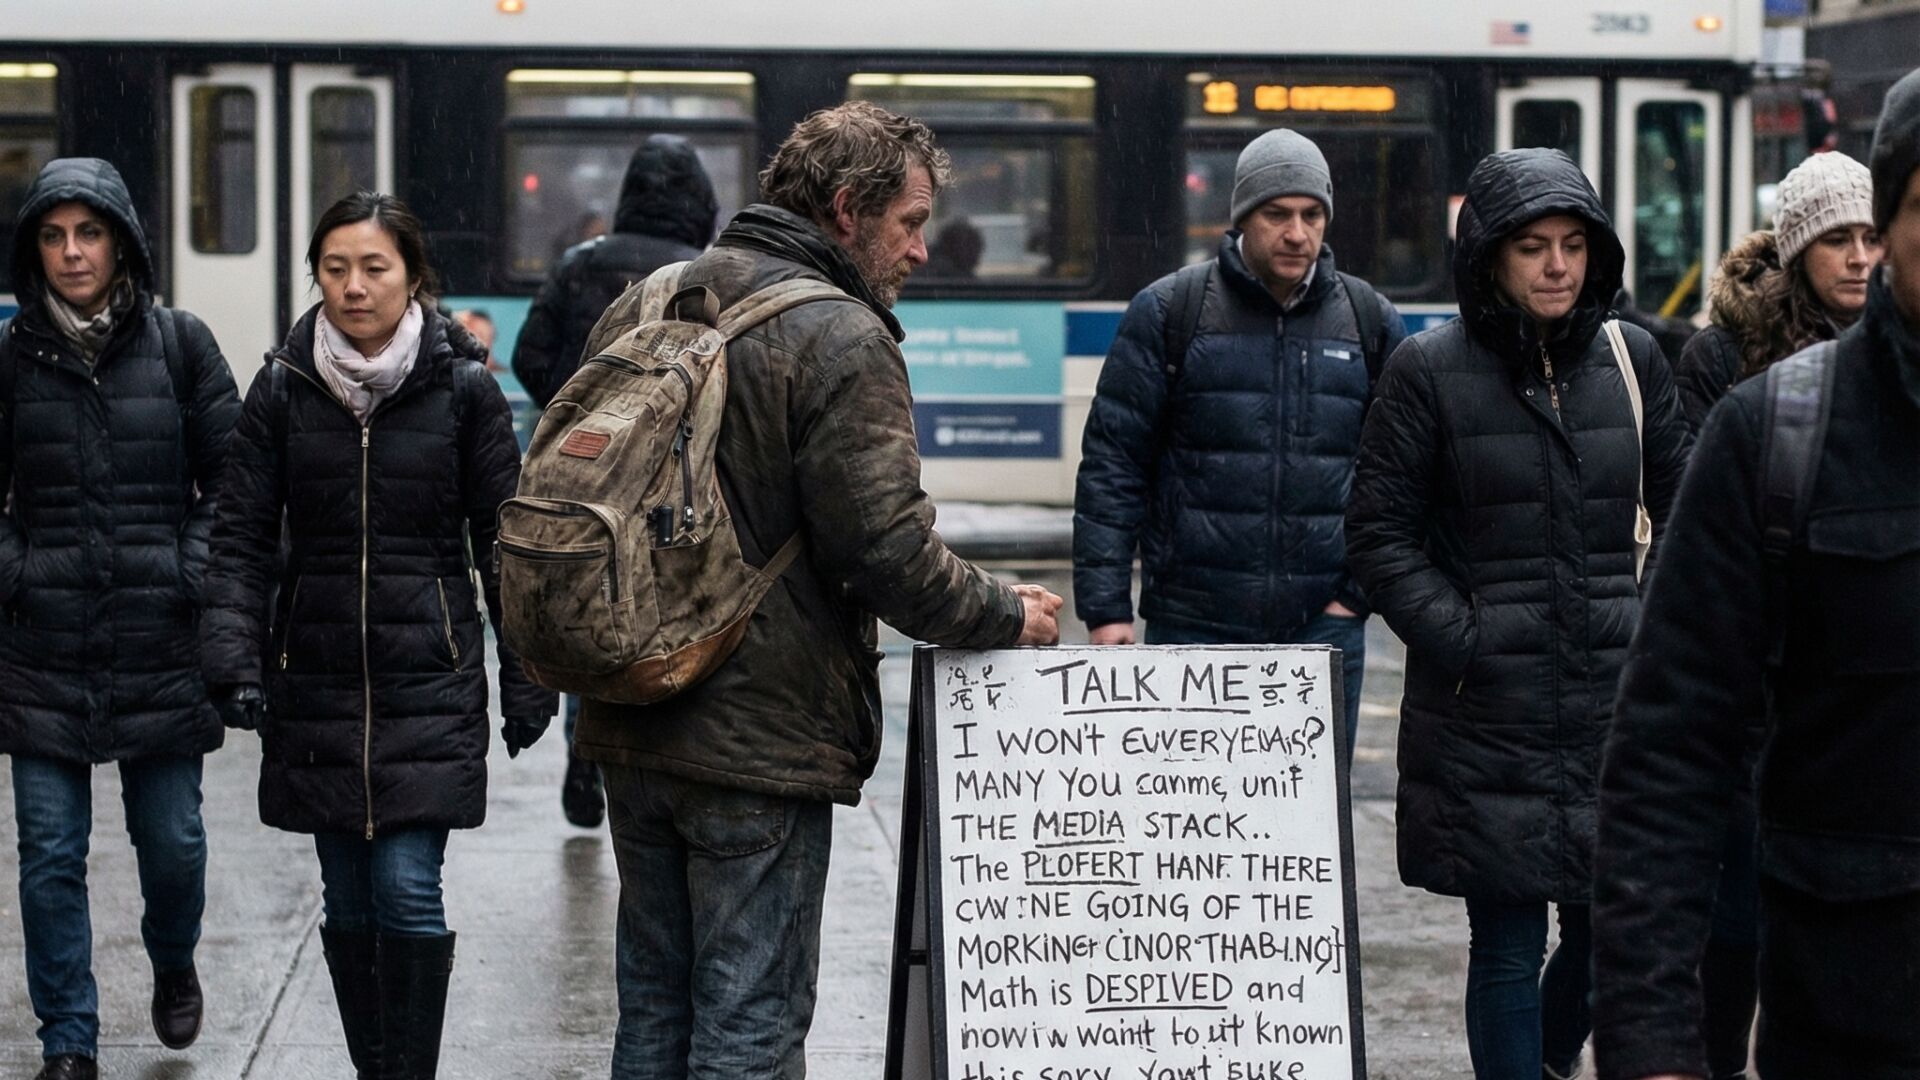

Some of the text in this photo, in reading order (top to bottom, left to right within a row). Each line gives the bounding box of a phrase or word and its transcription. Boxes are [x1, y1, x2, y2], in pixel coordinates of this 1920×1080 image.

[1035, 659, 1160, 705] TALK
[1181, 663, 1250, 705] ME
[952, 722, 979, 759] I
[956, 769, 1045, 803] MANY
[1058, 766, 1122, 802] YOU
[951, 814, 1017, 843] THE
[950, 853, 1009, 886] The
[1241, 853, 1333, 883] THERE
[1087, 890, 1189, 922] GOING
[1203, 894, 1241, 920] OF
[1251, 892, 1313, 923] THE
[961, 971, 1304, 1013] Math is DESPIVED and
[1256, 1011, 1343, 1045] known
